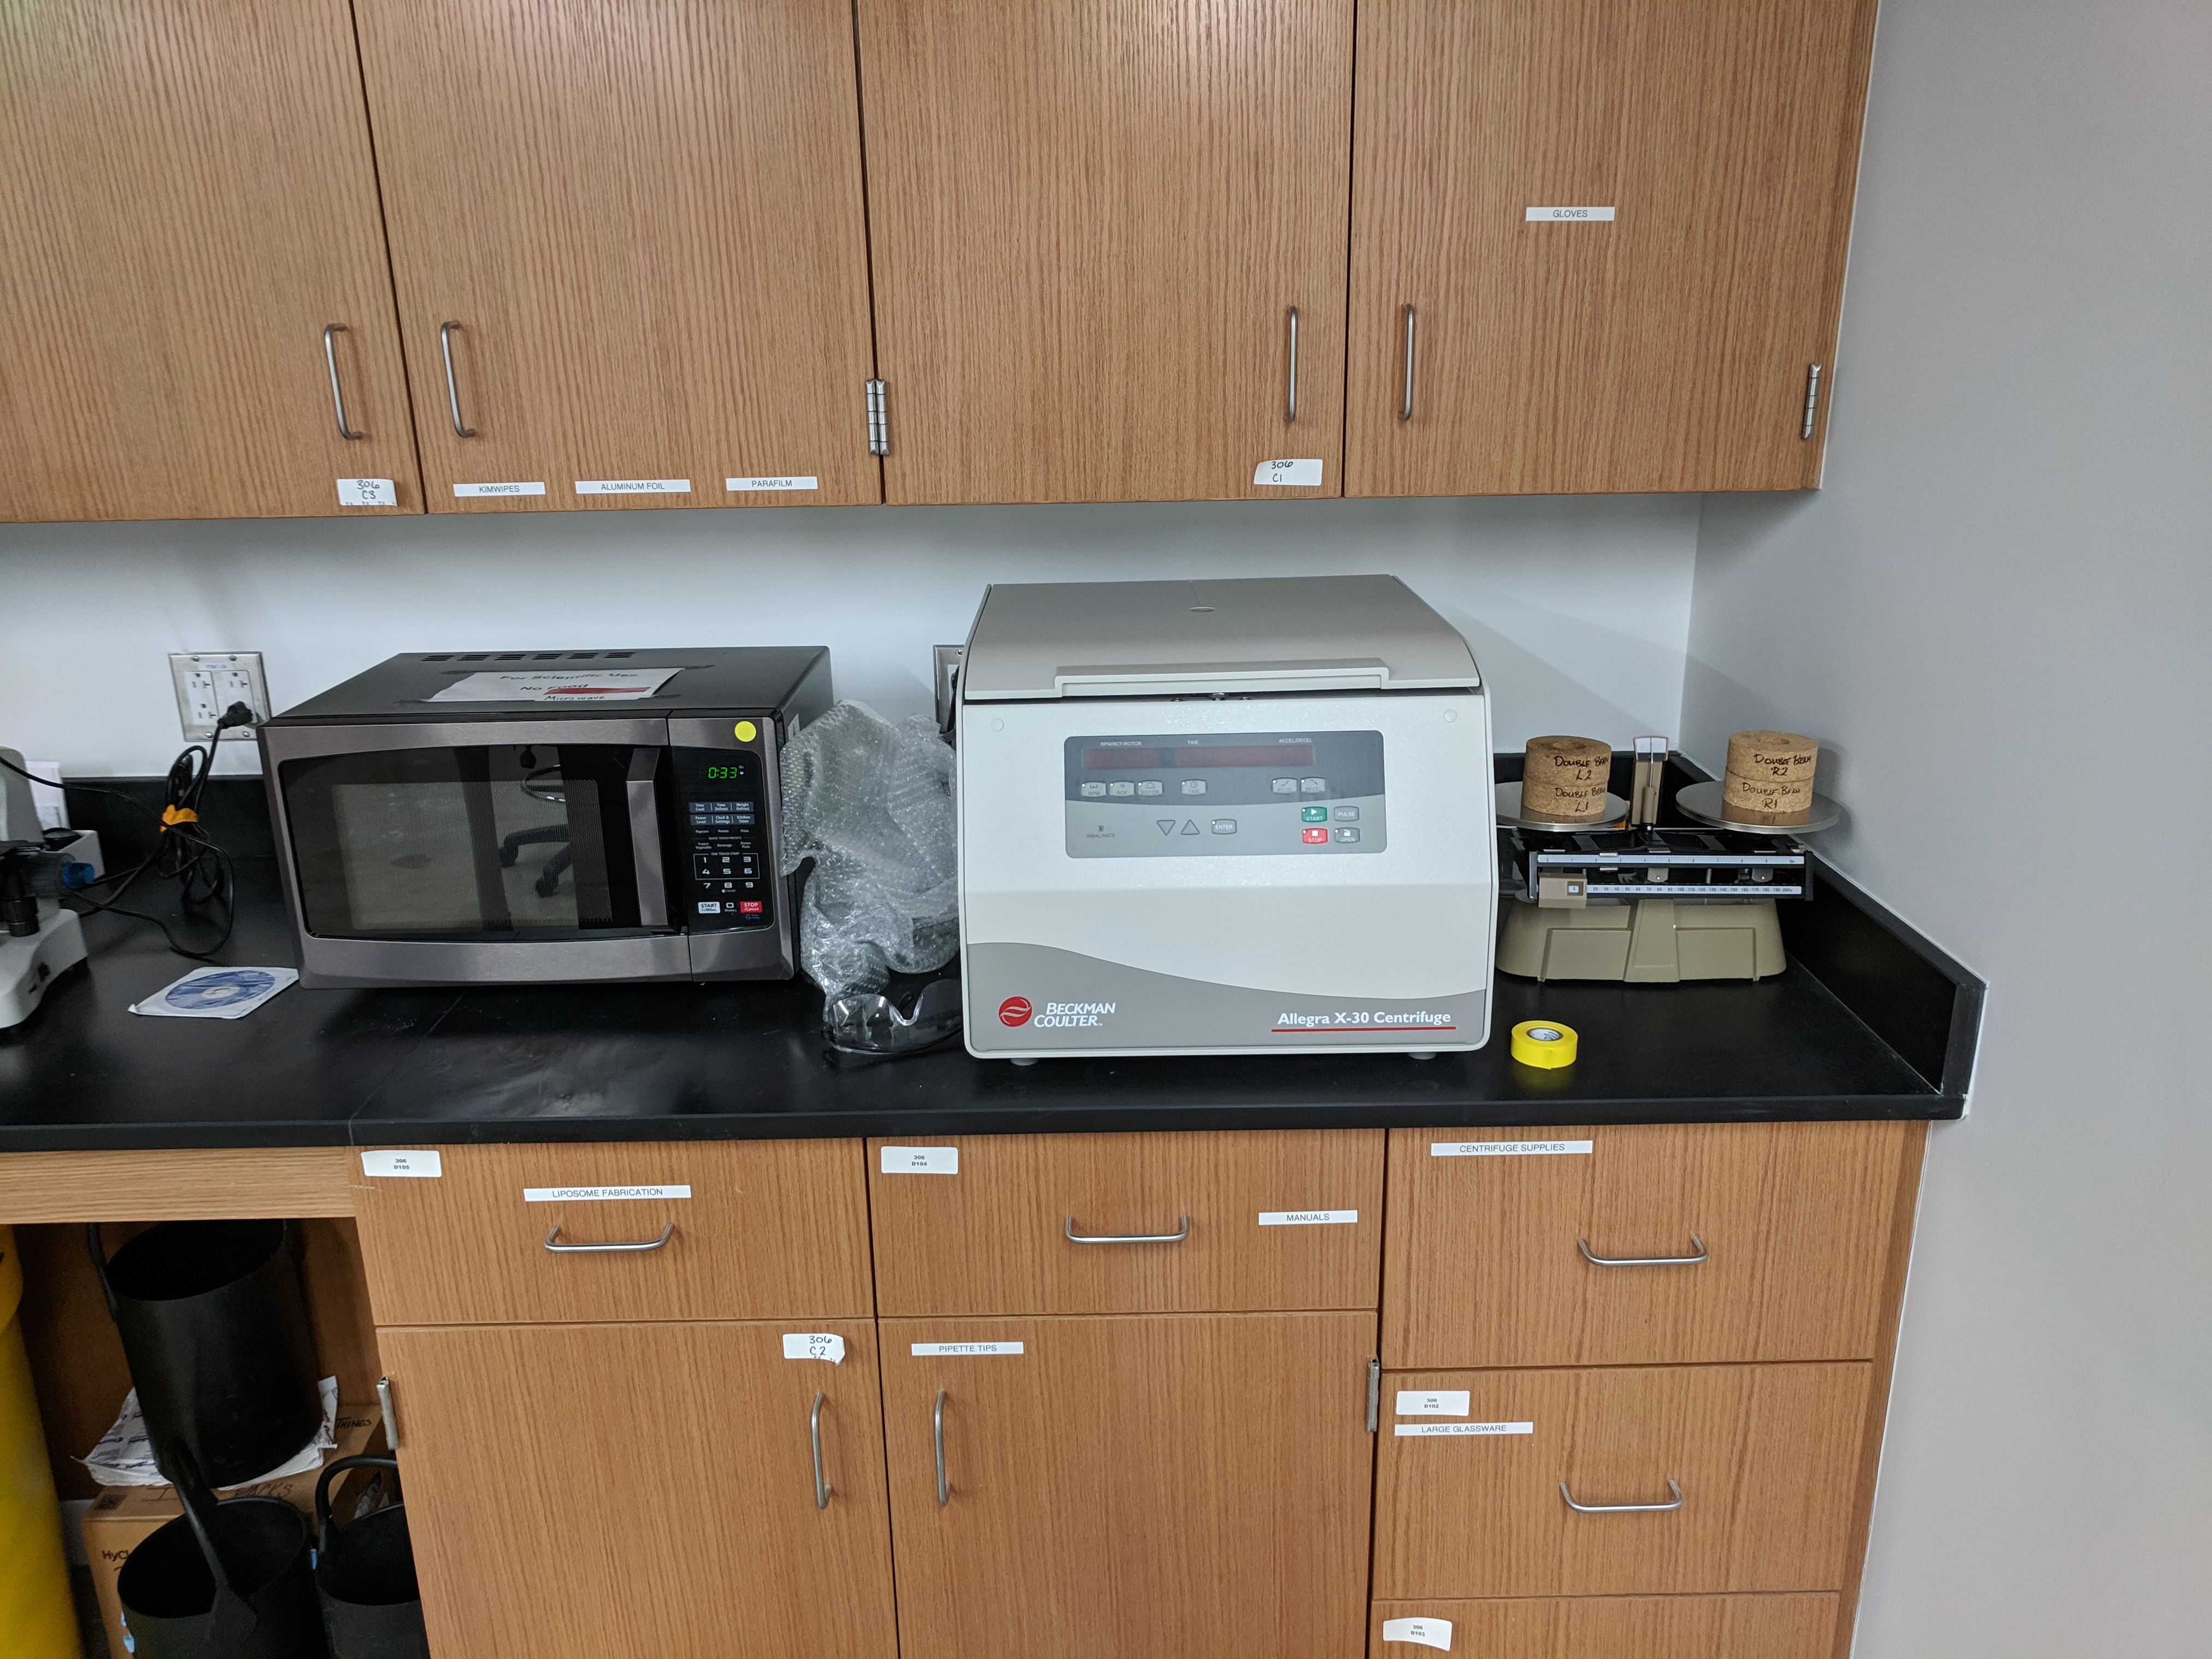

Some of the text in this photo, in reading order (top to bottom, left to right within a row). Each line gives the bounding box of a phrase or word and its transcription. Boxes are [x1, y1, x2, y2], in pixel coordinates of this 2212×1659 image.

[1552, 209, 1588, 218] GLOVES
[1271, 460, 1294, 470] 306
[751, 479, 792, 487] PARAFILM
[1272, 473, 1283, 483] C1
[356, 479, 380, 490] 306
[479, 485, 520, 493] KIMWIPES
[601, 482, 665, 491] ALUMINUM FOIL
[361, 490, 376, 499] C3
[708, 767, 738, 779] 0:33
[1575, 769, 1592, 781] L2
[1770, 766, 1789, 776] R2
[1574, 801, 1589, 813] L1
[1761, 797, 1778, 810] R1
[1046, 1002, 1116, 1015] BECKMAN
[1033, 1015, 1098, 1028] COULTER
[1277, 1010, 1451, 1028] Allegra X-30 Centrifuge
[1459, 1143, 1566, 1153] CENTRIFUGE SUPPLIES
[552, 1188, 663, 1198] LIPOSOME FABRICATION
[1286, 1213, 1330, 1222] MANUALS
[809, 1335, 832, 1344] 306
[809, 1345, 826, 1356] C2
[1452, 1425, 1507, 1433] GLASSWARE
